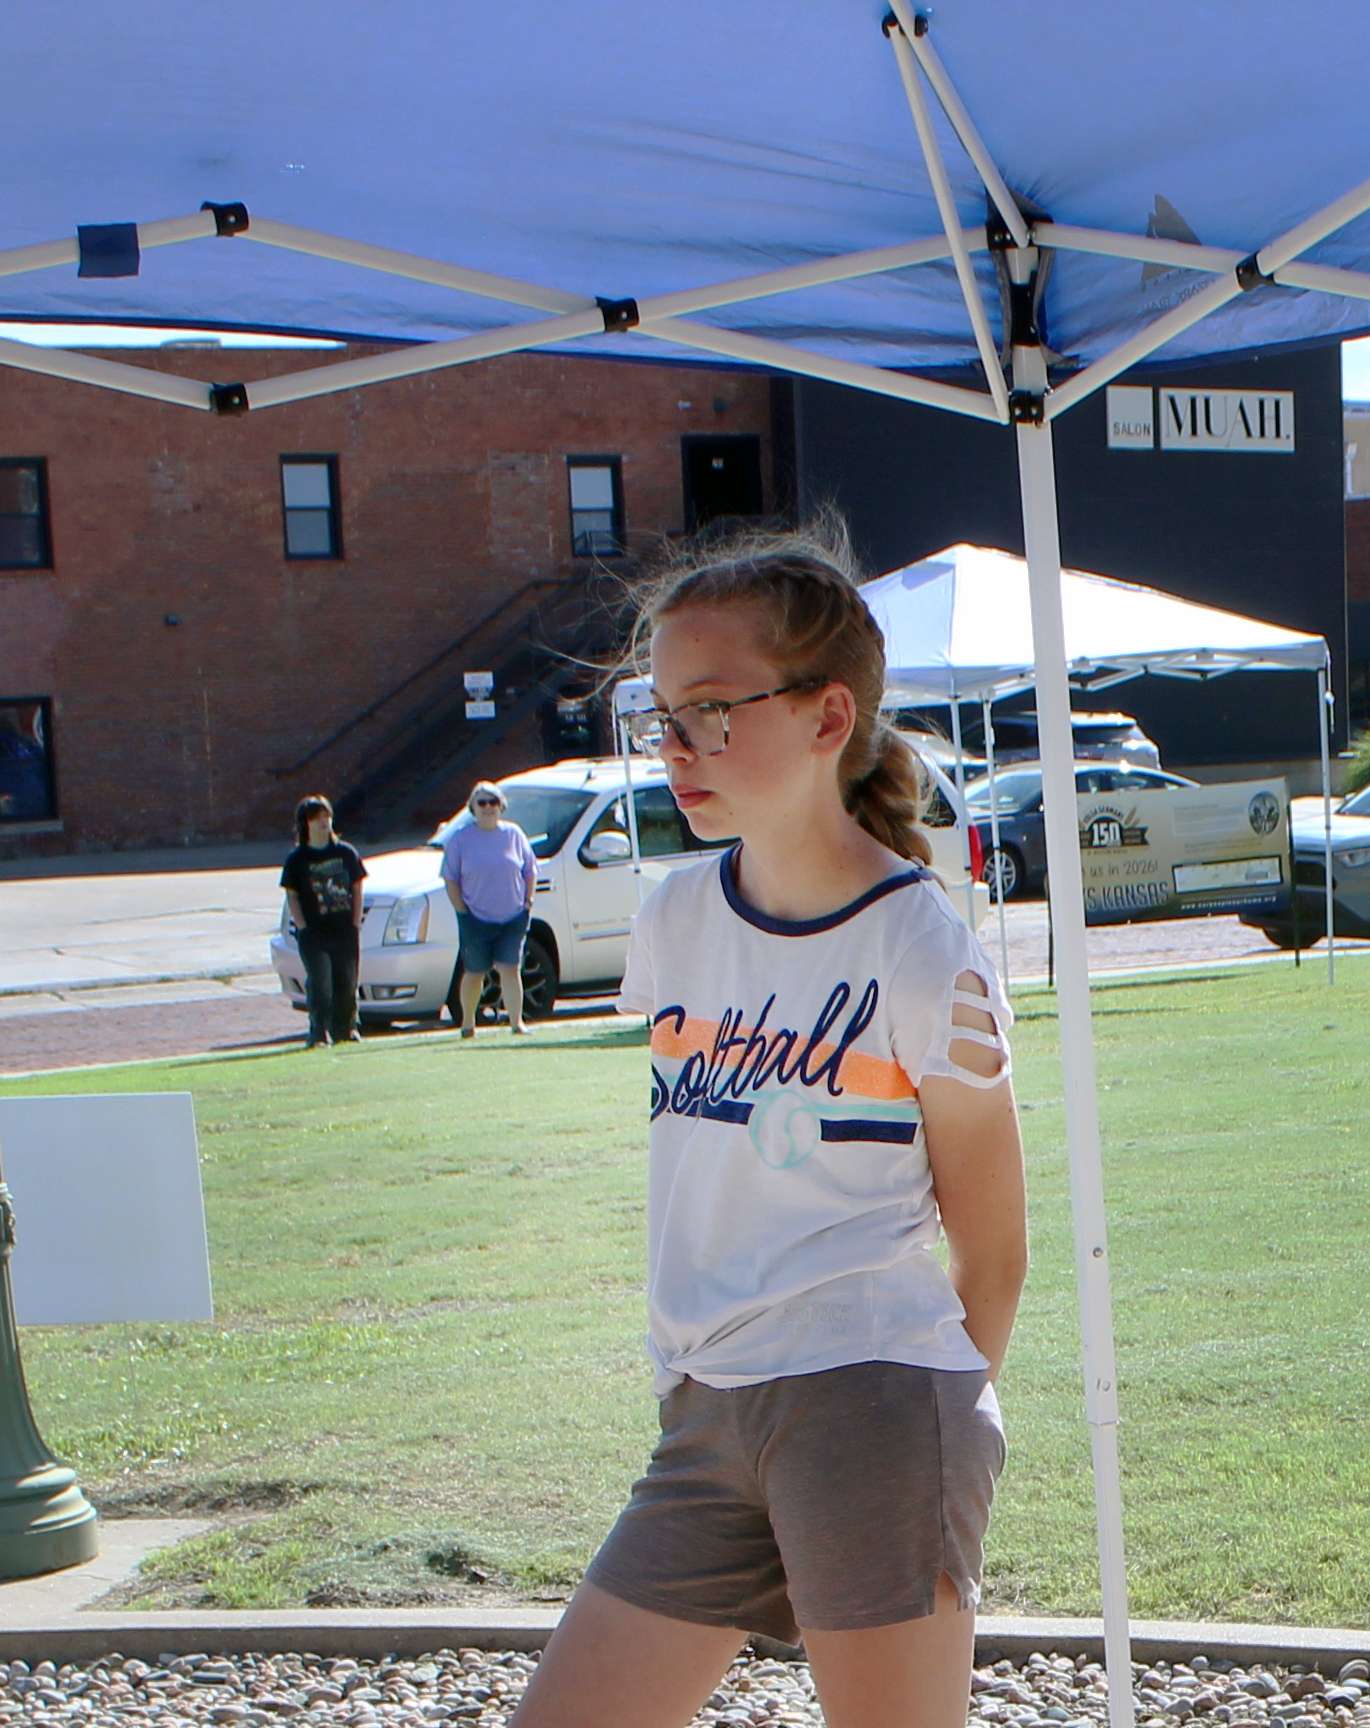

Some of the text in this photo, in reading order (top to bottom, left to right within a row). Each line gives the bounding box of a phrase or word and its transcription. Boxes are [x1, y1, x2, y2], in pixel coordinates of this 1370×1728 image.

[1112, 394, 1291, 448] SALON MUAH.
[1092, 822, 1121, 847] 150
[1103, 881, 1169, 912] KANSAS
[650, 977, 879, 1122] Softball
